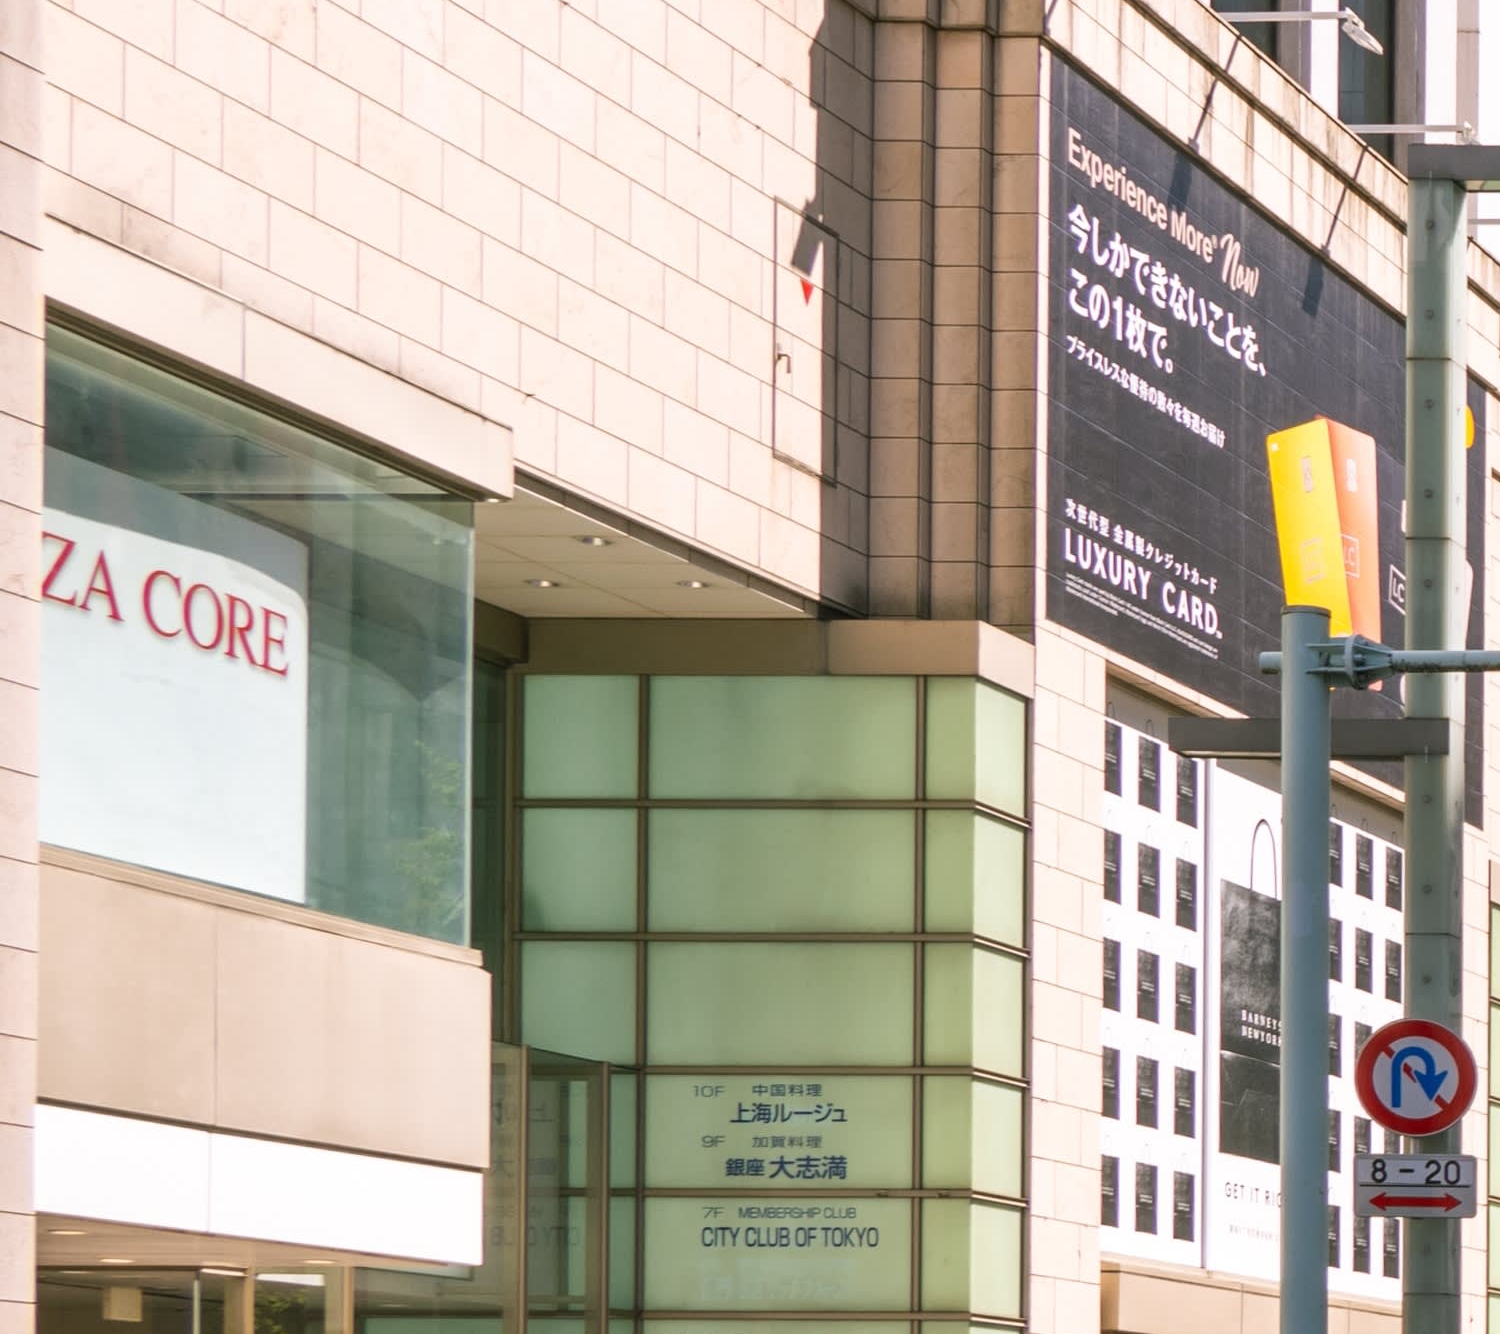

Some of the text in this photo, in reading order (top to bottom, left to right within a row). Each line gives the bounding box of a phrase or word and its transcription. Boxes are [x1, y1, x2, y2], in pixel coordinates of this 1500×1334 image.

[1067, 127, 1168, 231] Experience
[1220, 233, 1260, 298] Now
[1068, 204, 1267, 377] 今しかできないことを、
[1068, 268, 1174, 373] この1枚で。
[1065, 498, 1219, 596] 次世代型 金属製クレジットカード
[1064, 527, 1153, 601] LUXURY
[41, 532, 289, 677] ZA CORE
[1241, 1009, 1282, 1033] BARNEYS
[693, 1083, 823, 1098] 10F 中国料理
[729, 1102, 848, 1125] 上海ルージュ
[701, 1135, 823, 1149] 9F 加賀料理
[725, 1155, 848, 1180] 銀座 大志満
[1371, 1159, 1388, 1185] 8
[1424, 1159, 1461, 1185] 20
[1224, 1181, 1245, 1201] GET
[1250, 1186, 1260, 1199] IT
[702, 1206, 858, 1220] 7F MEMBERSHIP CLUB
[701, 1226, 880, 1249] CITY CLUB OF TOKYO
